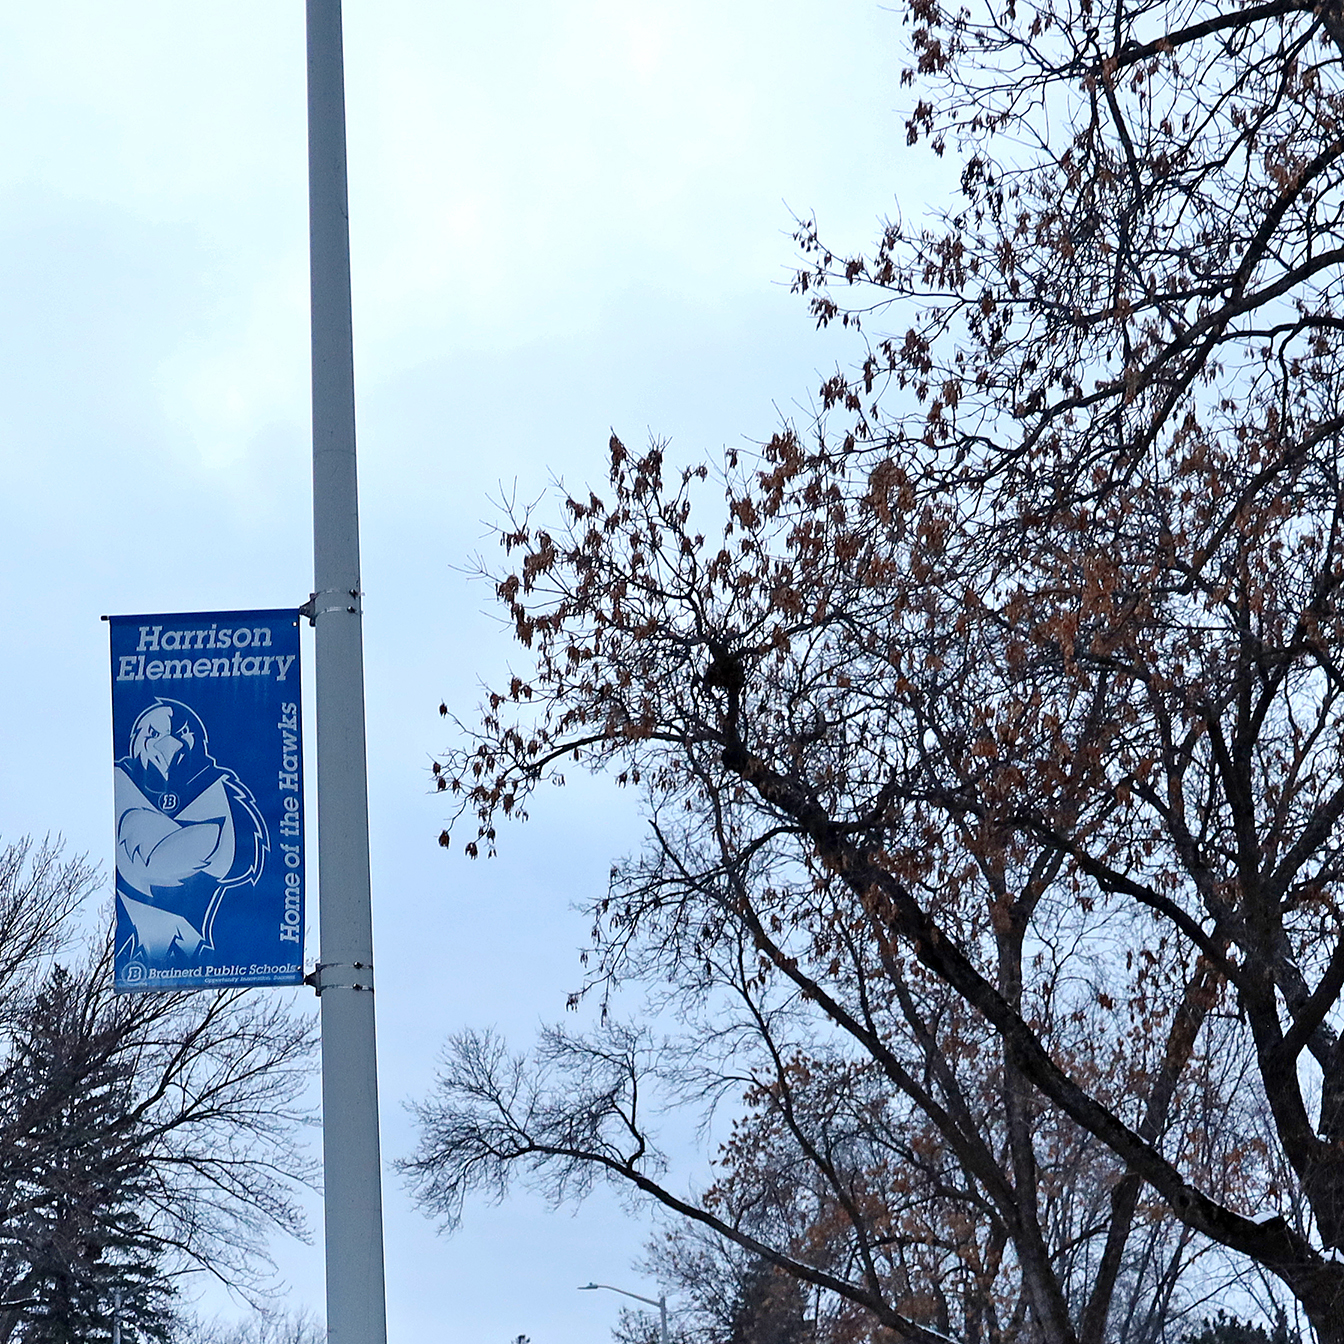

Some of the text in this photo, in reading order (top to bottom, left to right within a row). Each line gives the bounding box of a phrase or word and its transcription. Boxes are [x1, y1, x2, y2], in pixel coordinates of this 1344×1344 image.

[136, 624, 272, 651] Harrison
[115, 651, 296, 682] Elementary
[162, 794, 177, 809] B
[278, 702, 301, 944] Home of the Hawks
[148, 963, 297, 979] Brainerd Public Schools
